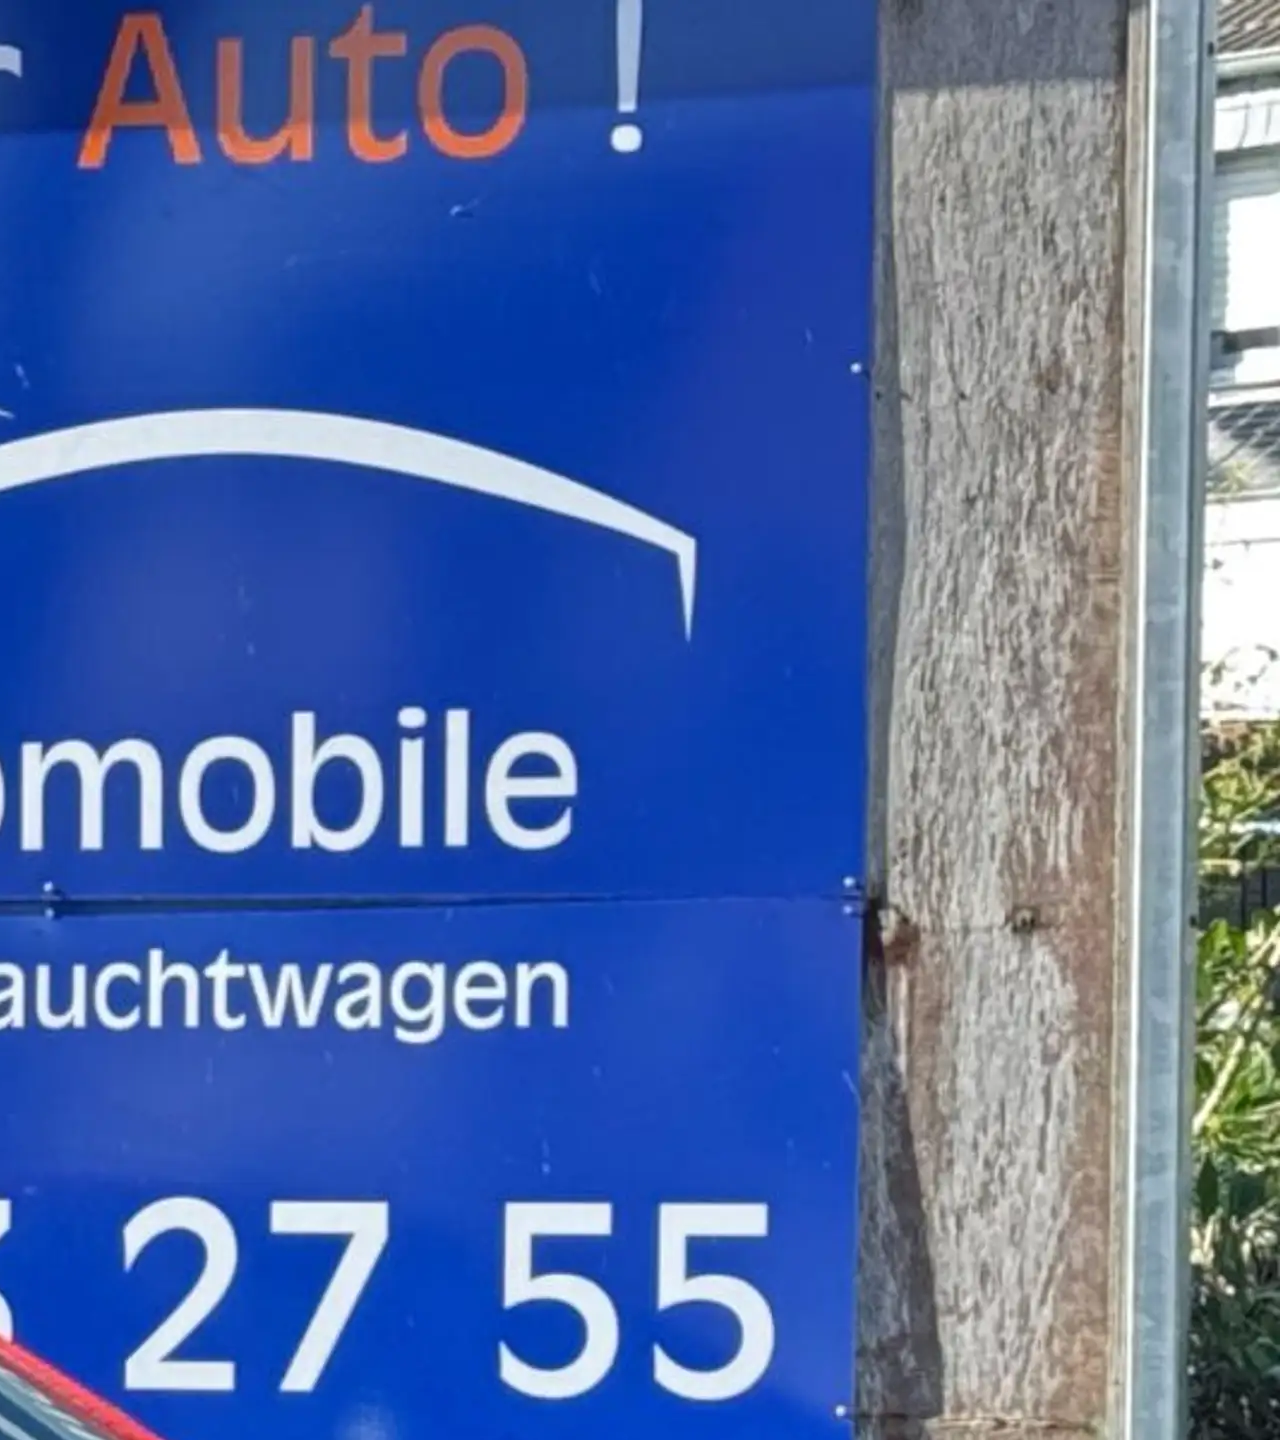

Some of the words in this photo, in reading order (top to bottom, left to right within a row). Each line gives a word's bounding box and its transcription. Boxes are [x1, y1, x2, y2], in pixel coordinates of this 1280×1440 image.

[77, 4, 528, 170] Auto
[122, 1199, 390, 1396] 27
[499, 1201, 776, 1403] 55
